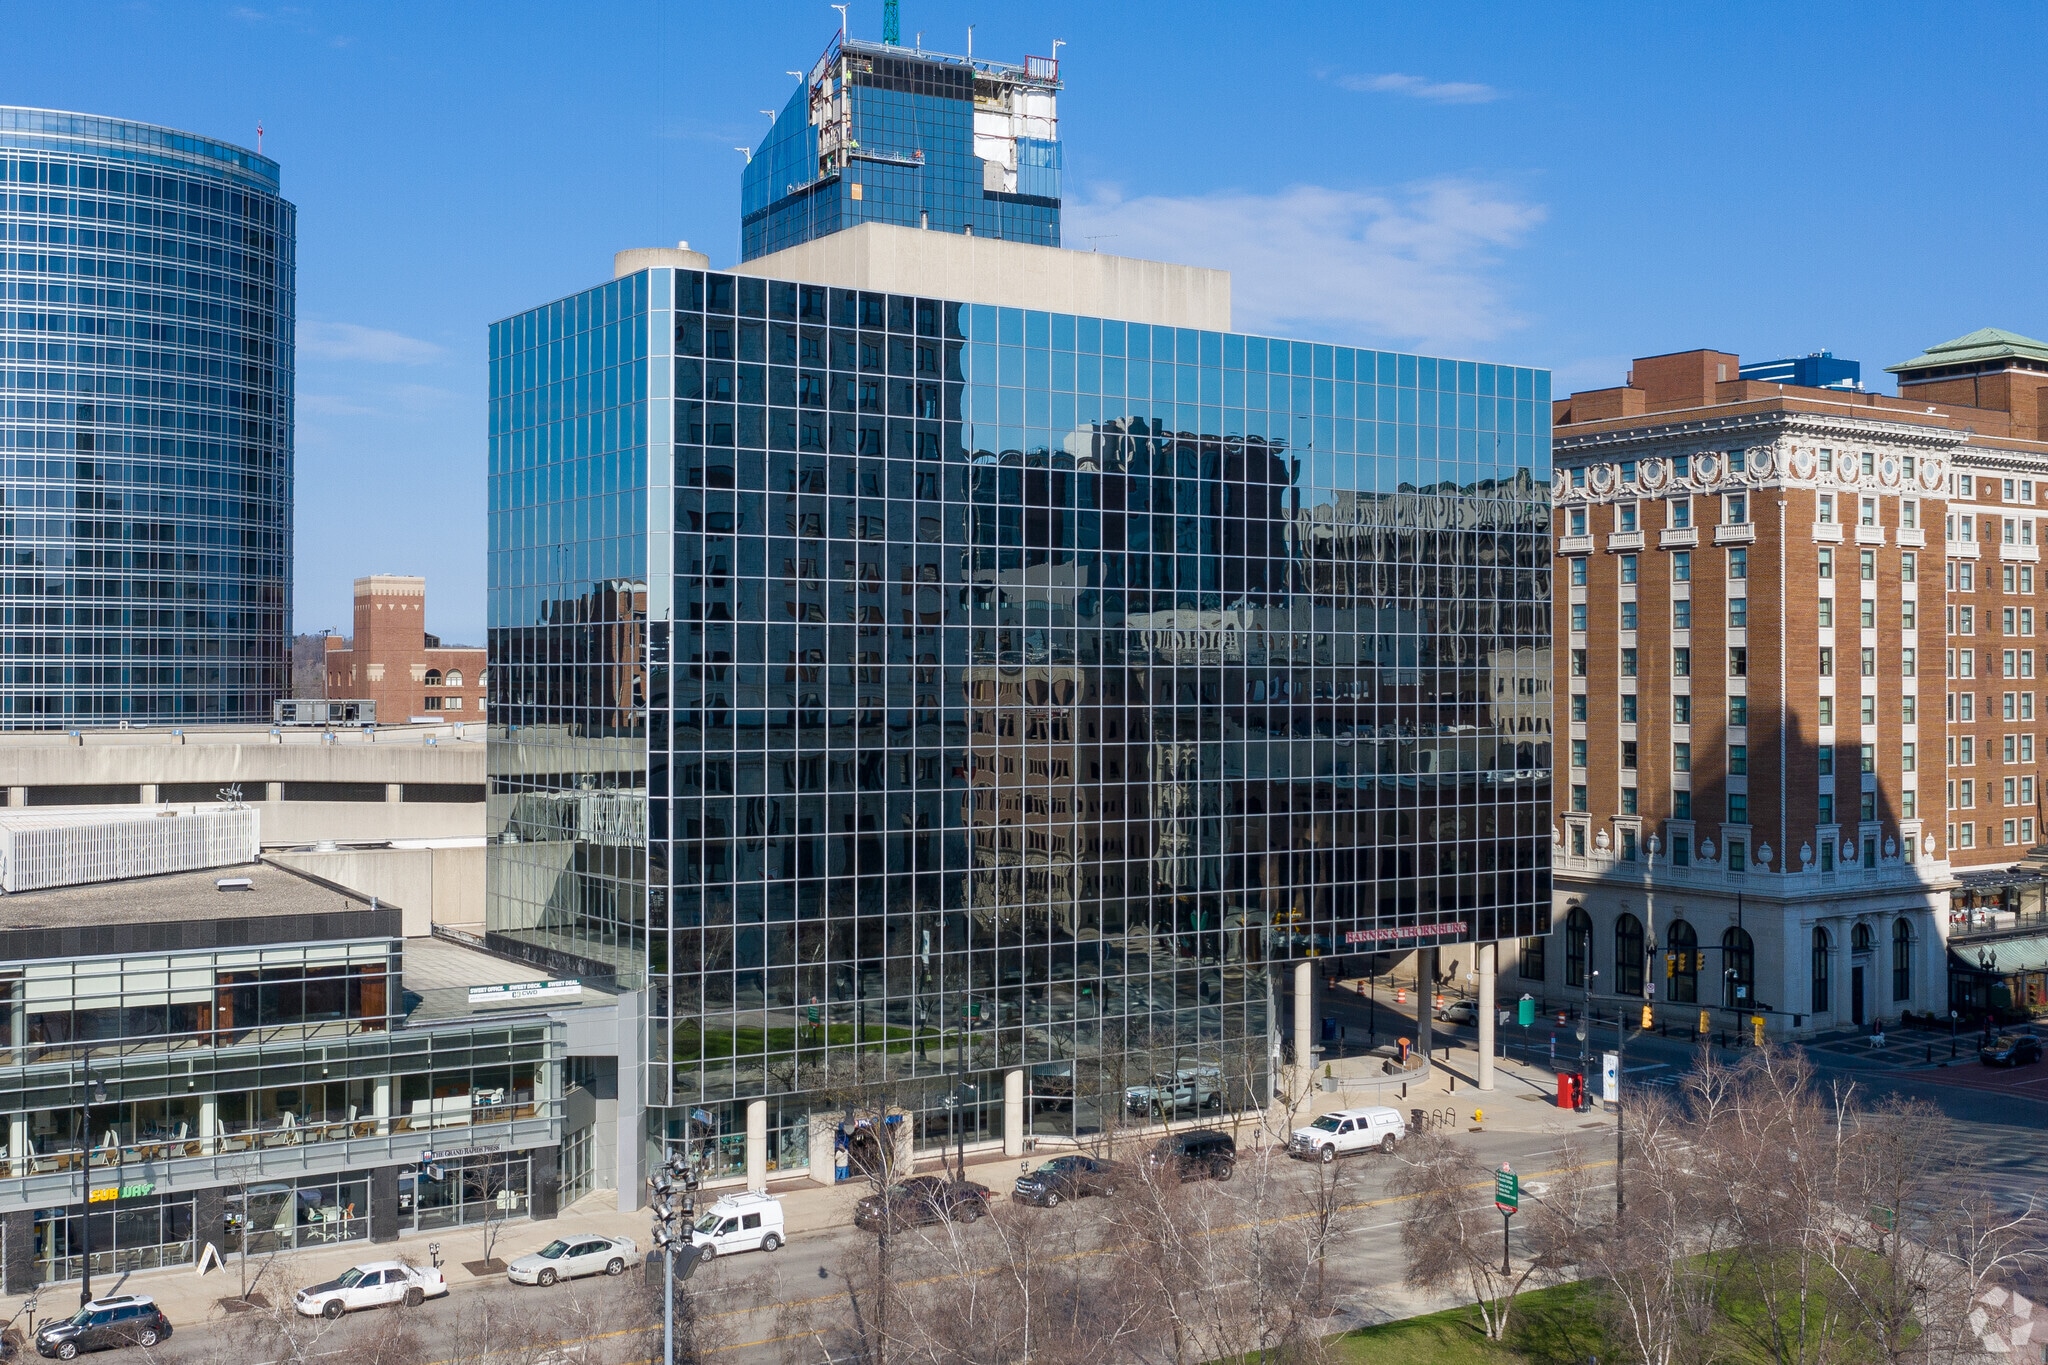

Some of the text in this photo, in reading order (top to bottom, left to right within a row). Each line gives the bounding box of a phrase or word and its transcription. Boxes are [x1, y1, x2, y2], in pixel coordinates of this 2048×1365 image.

[1345, 922, 1468, 943] BARNES & THORNBURG
[89, 1183, 154, 1203] SUBWAY
